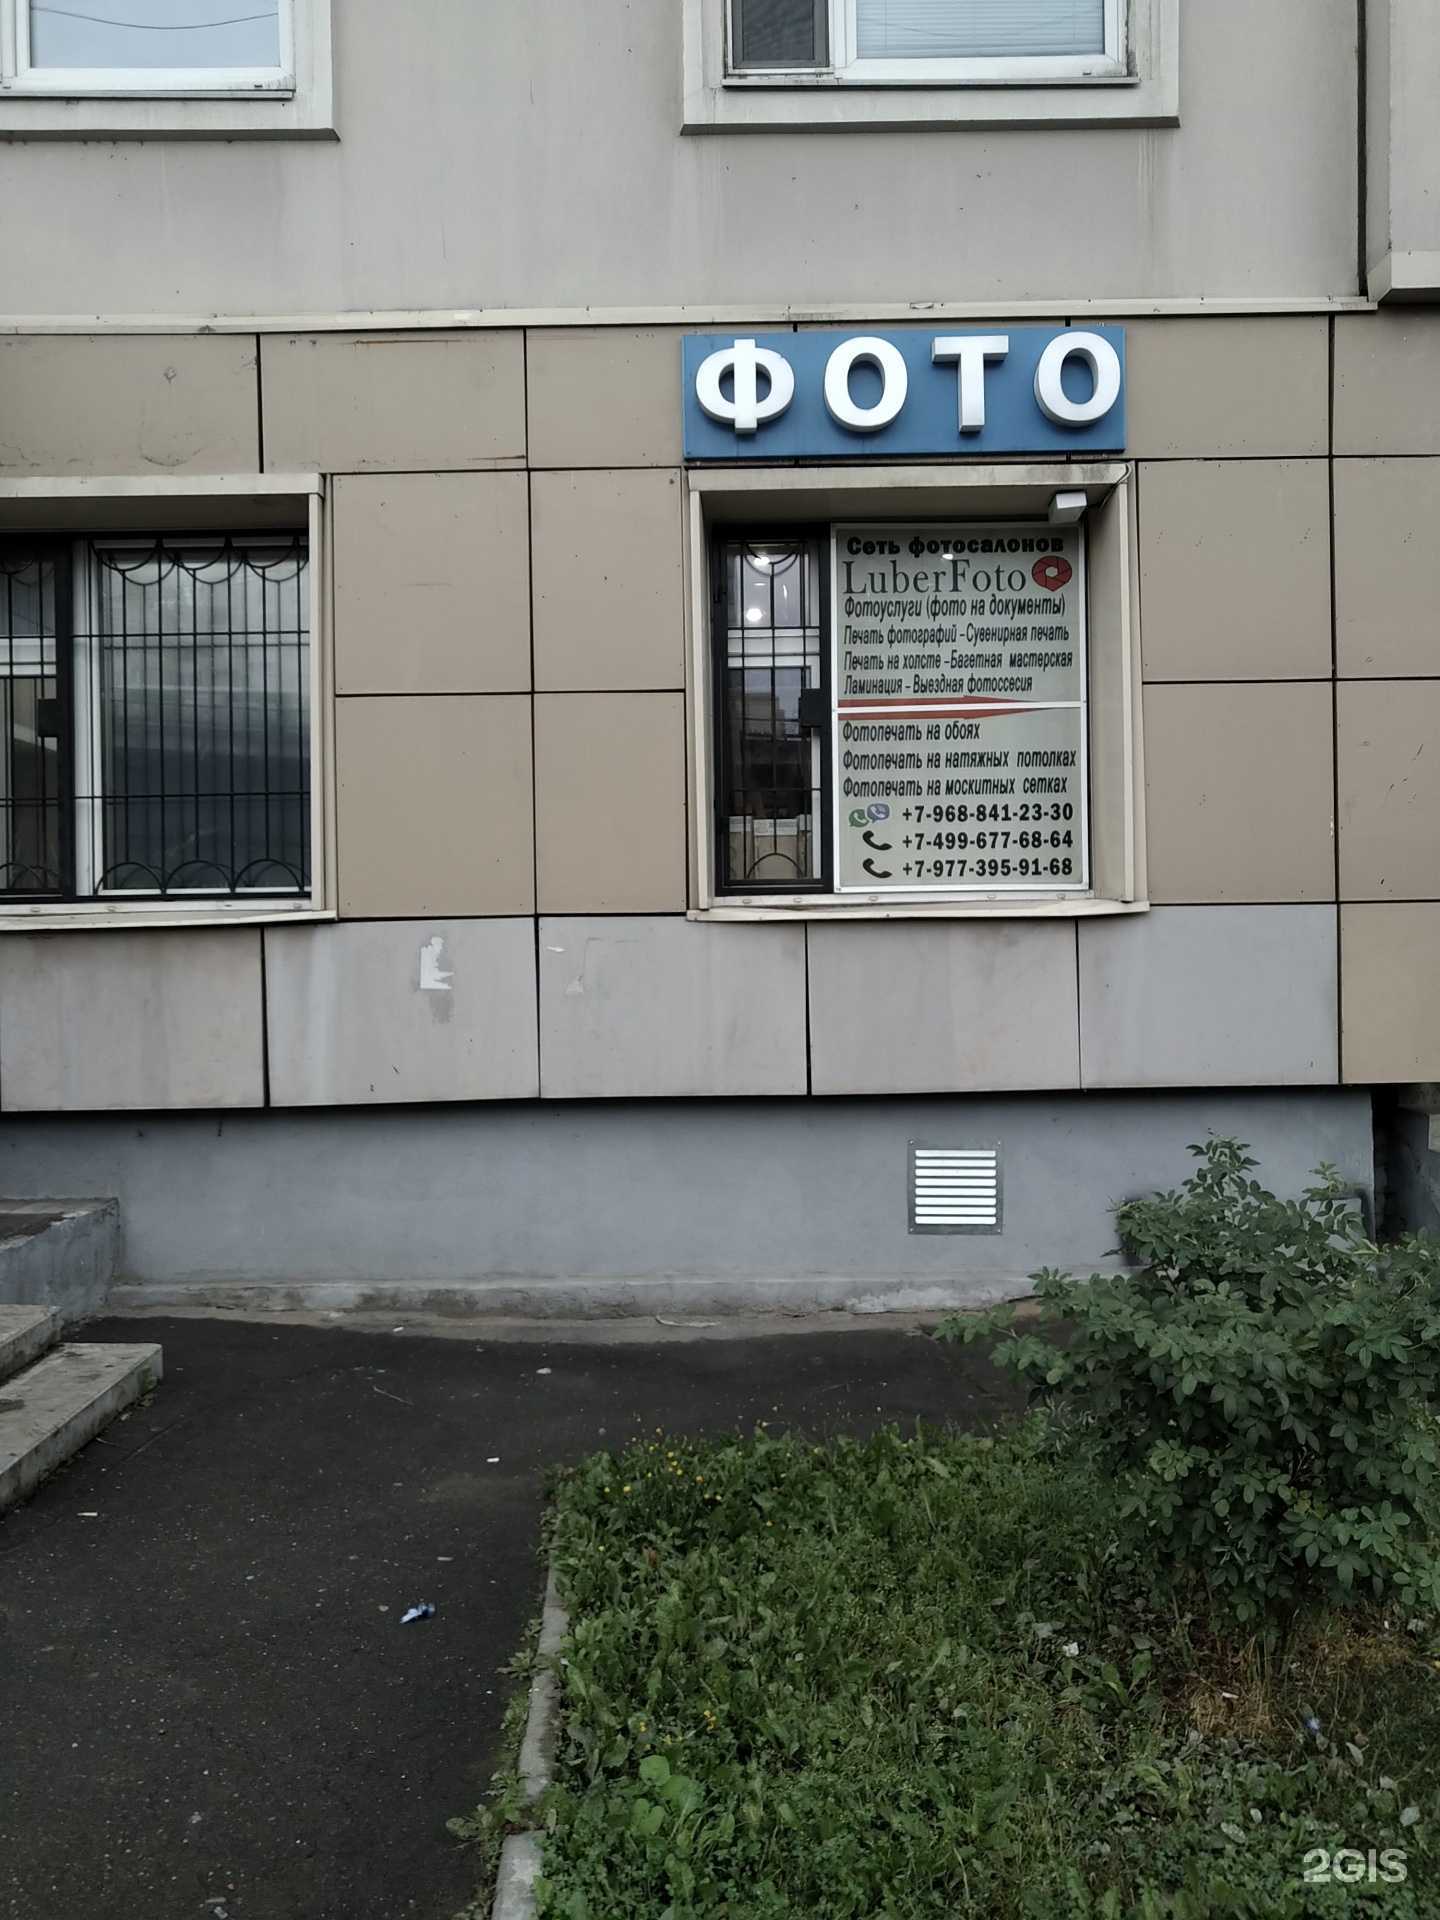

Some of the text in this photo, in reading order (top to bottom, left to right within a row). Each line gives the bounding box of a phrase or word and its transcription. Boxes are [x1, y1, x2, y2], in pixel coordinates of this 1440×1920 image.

[695, 331, 1121, 435] ФОТО
[846, 536, 1064, 558] Сеть фотосалонов
[842, 559, 1026, 594] LuberFoto
[844, 593, 1065, 622] Фотоуслуги (фото на документы)
[843, 625, 884, 645] Печать
[887, 624, 957, 648] фотографий
[1030, 625, 1070, 641] печать
[843, 651, 884, 671] Печать
[887, 655, 899, 669] на
[902, 653, 941, 669] холсте
[1009, 651, 1073, 672] мастерская
[844, 675, 903, 695] Ламинация
[913, 674, 964, 694] Выездная
[842, 720, 981, 743] Фотопечать на обоях
[842, 750, 1077, 770] Фотопечать на натяжных потолках
[842, 776, 1068, 797] Фотопечать на москитных сетках
[902, 803, 1073, 823] +7-968-841-23-30
[902, 830, 1073, 850] +7-499-677-68-64
[902, 857, 1073, 878] +7-977-395-91-68
